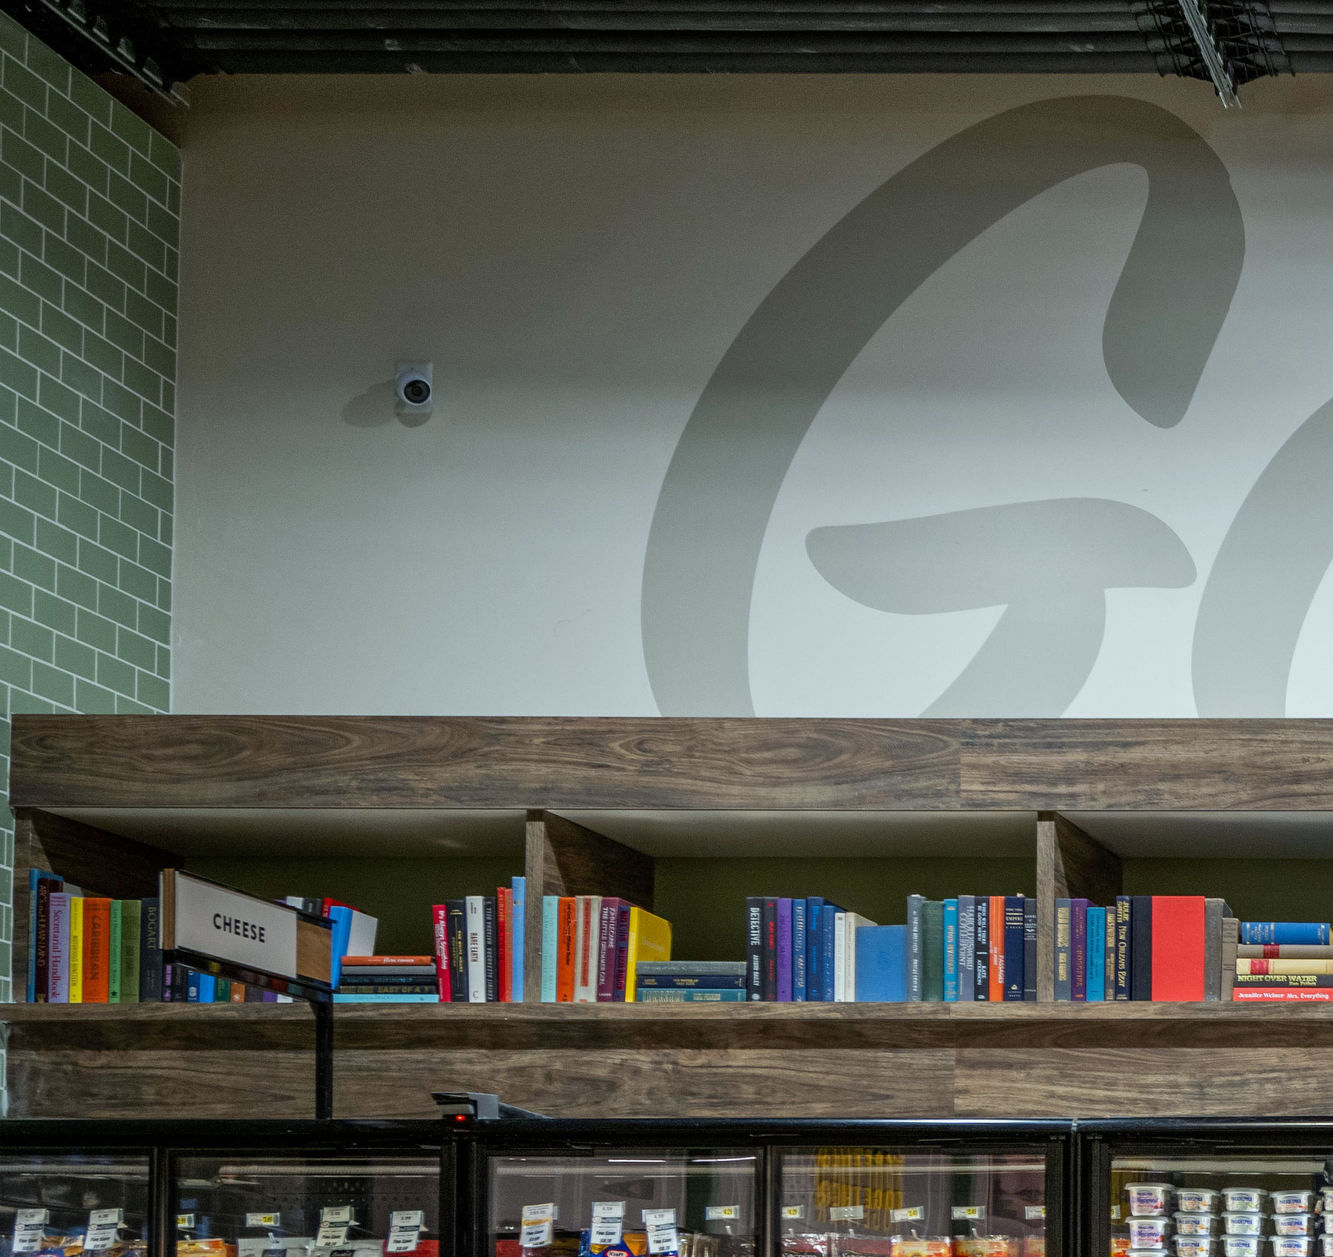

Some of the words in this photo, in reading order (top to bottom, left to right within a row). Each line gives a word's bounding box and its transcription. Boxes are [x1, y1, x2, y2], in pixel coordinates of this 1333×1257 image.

[51, 910, 62, 953] Secretarial
[147, 906, 157, 950] BOGART
[212, 912, 266, 944] CHEESE
[470, 933, 478, 945] RARE
[750, 907, 761, 945] DETECTIVE
[89, 915, 101, 980] CARIBBEAN
[470, 947, 478, 962] EARTH
[51, 956, 62, 999] Handbook
[1300, 992, 1329, 1000] Everything
